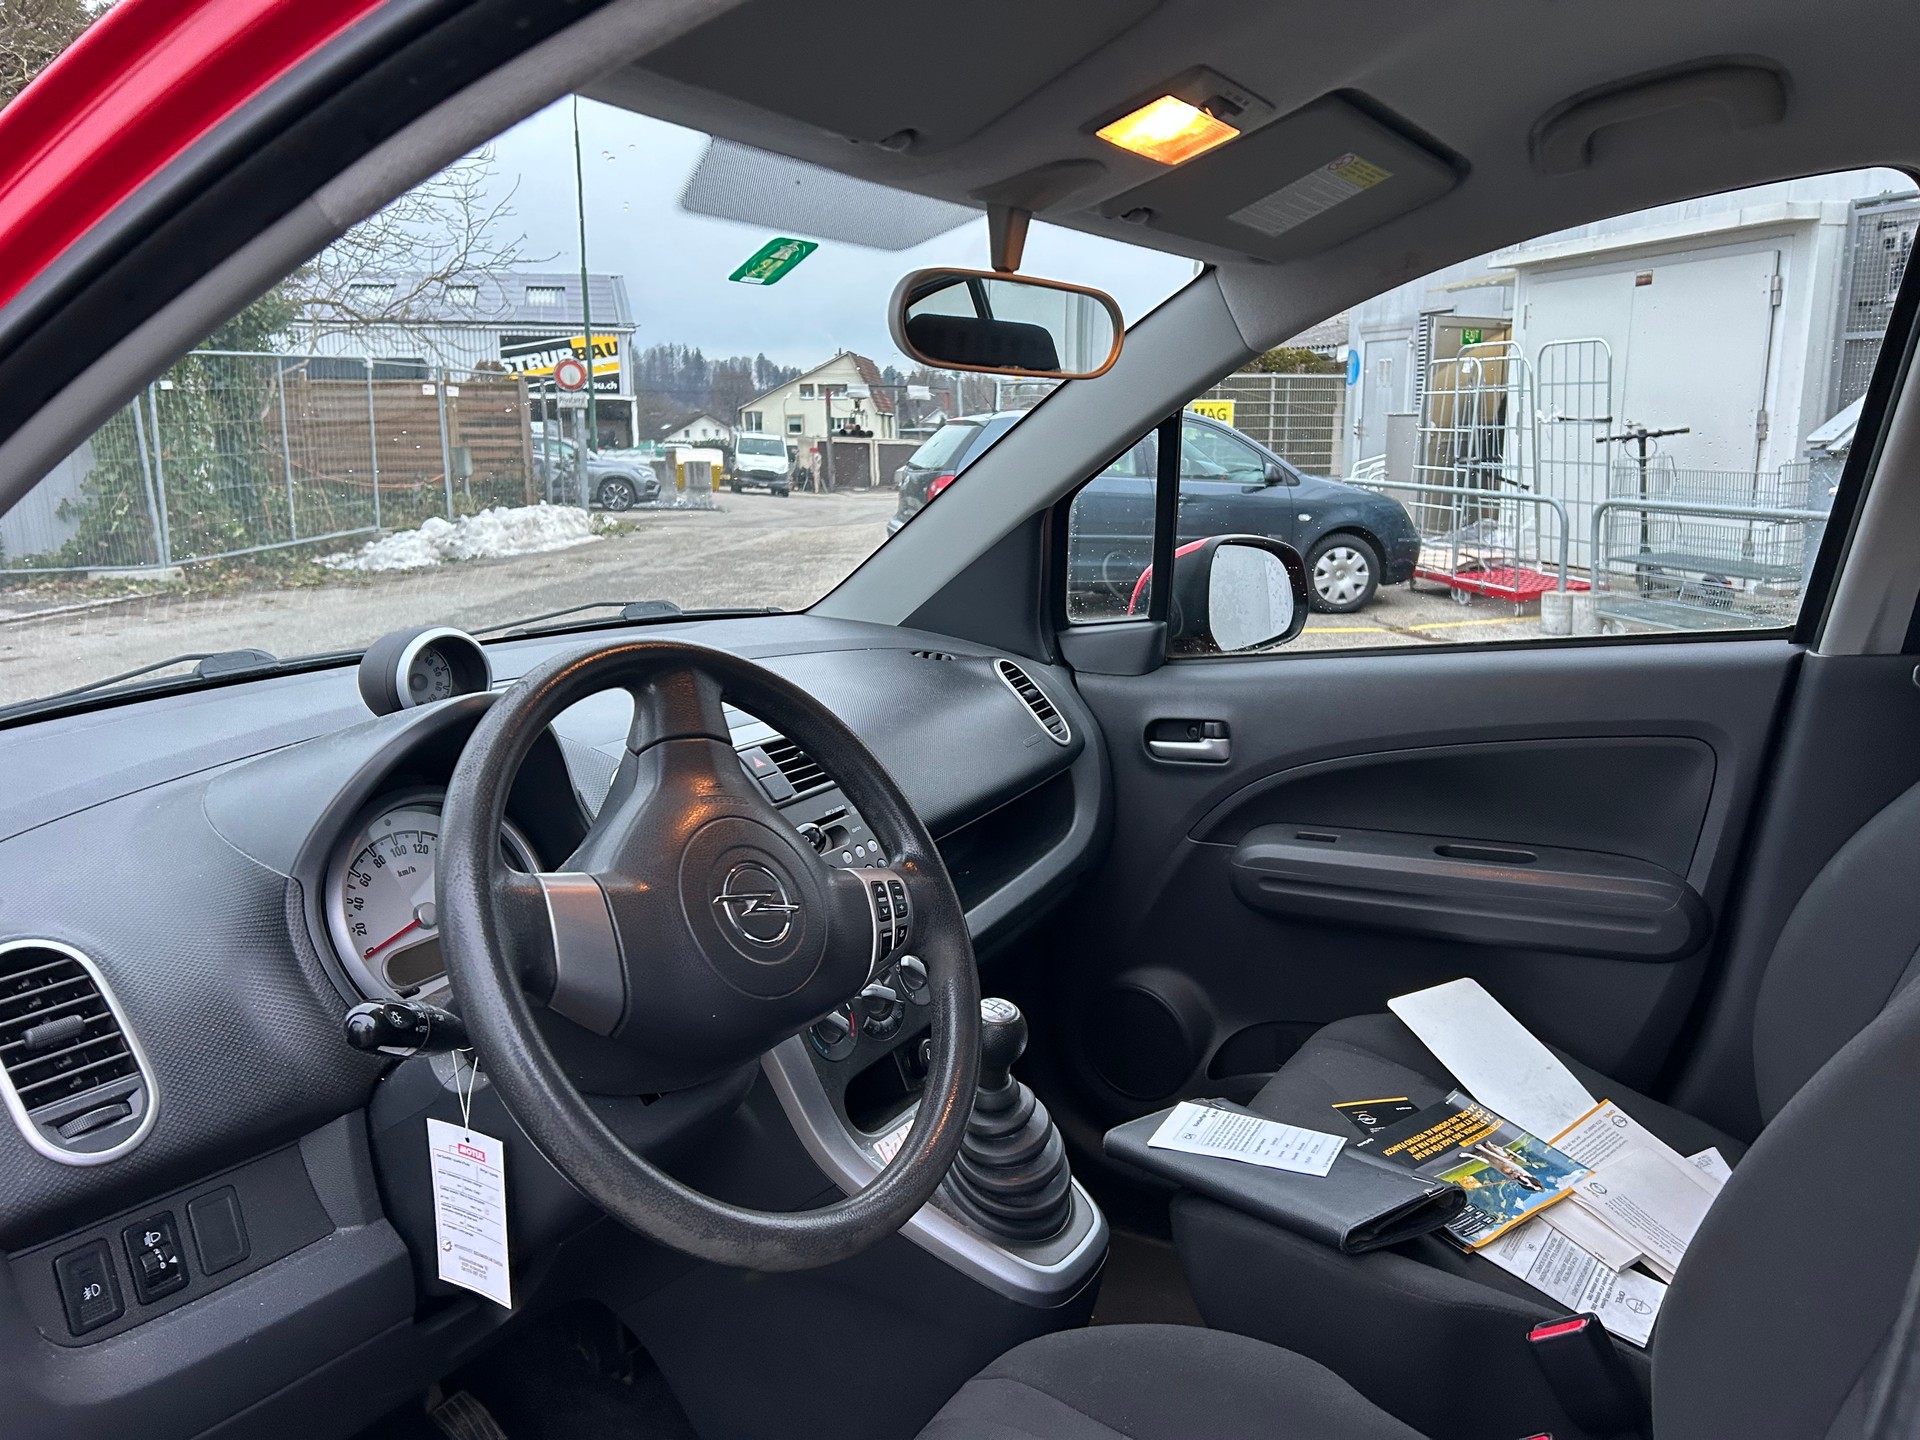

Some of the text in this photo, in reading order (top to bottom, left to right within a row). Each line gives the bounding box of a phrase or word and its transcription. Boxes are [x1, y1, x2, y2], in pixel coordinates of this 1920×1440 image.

[390, 844, 408, 858] 100
[412, 843, 429, 855] 120
[372, 854, 386, 869] 80
[396, 865, 417, 878] km/h
[359, 872, 372, 888] 60
[353, 897, 365, 911] 40
[355, 922, 368, 937] 20
[459, 1145, 485, 1161] MOTUL
